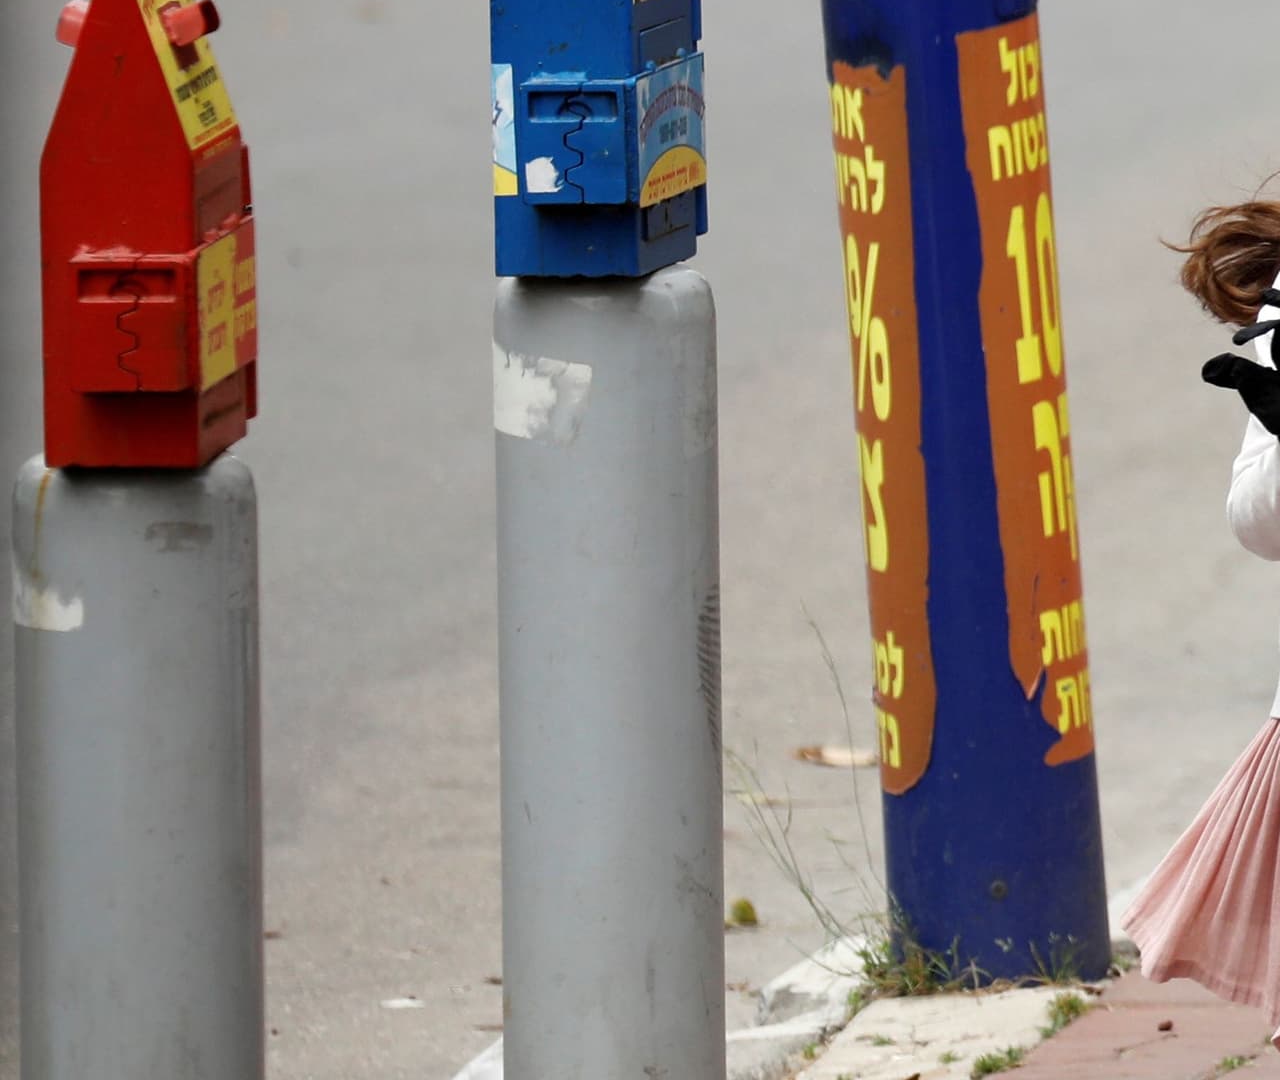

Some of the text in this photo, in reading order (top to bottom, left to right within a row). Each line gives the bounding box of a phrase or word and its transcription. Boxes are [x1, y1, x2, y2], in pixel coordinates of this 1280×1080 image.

[998, 37, 1039, 106] כול
[829, 83, 865, 143] את
[835, 145, 885, 215] להיו
